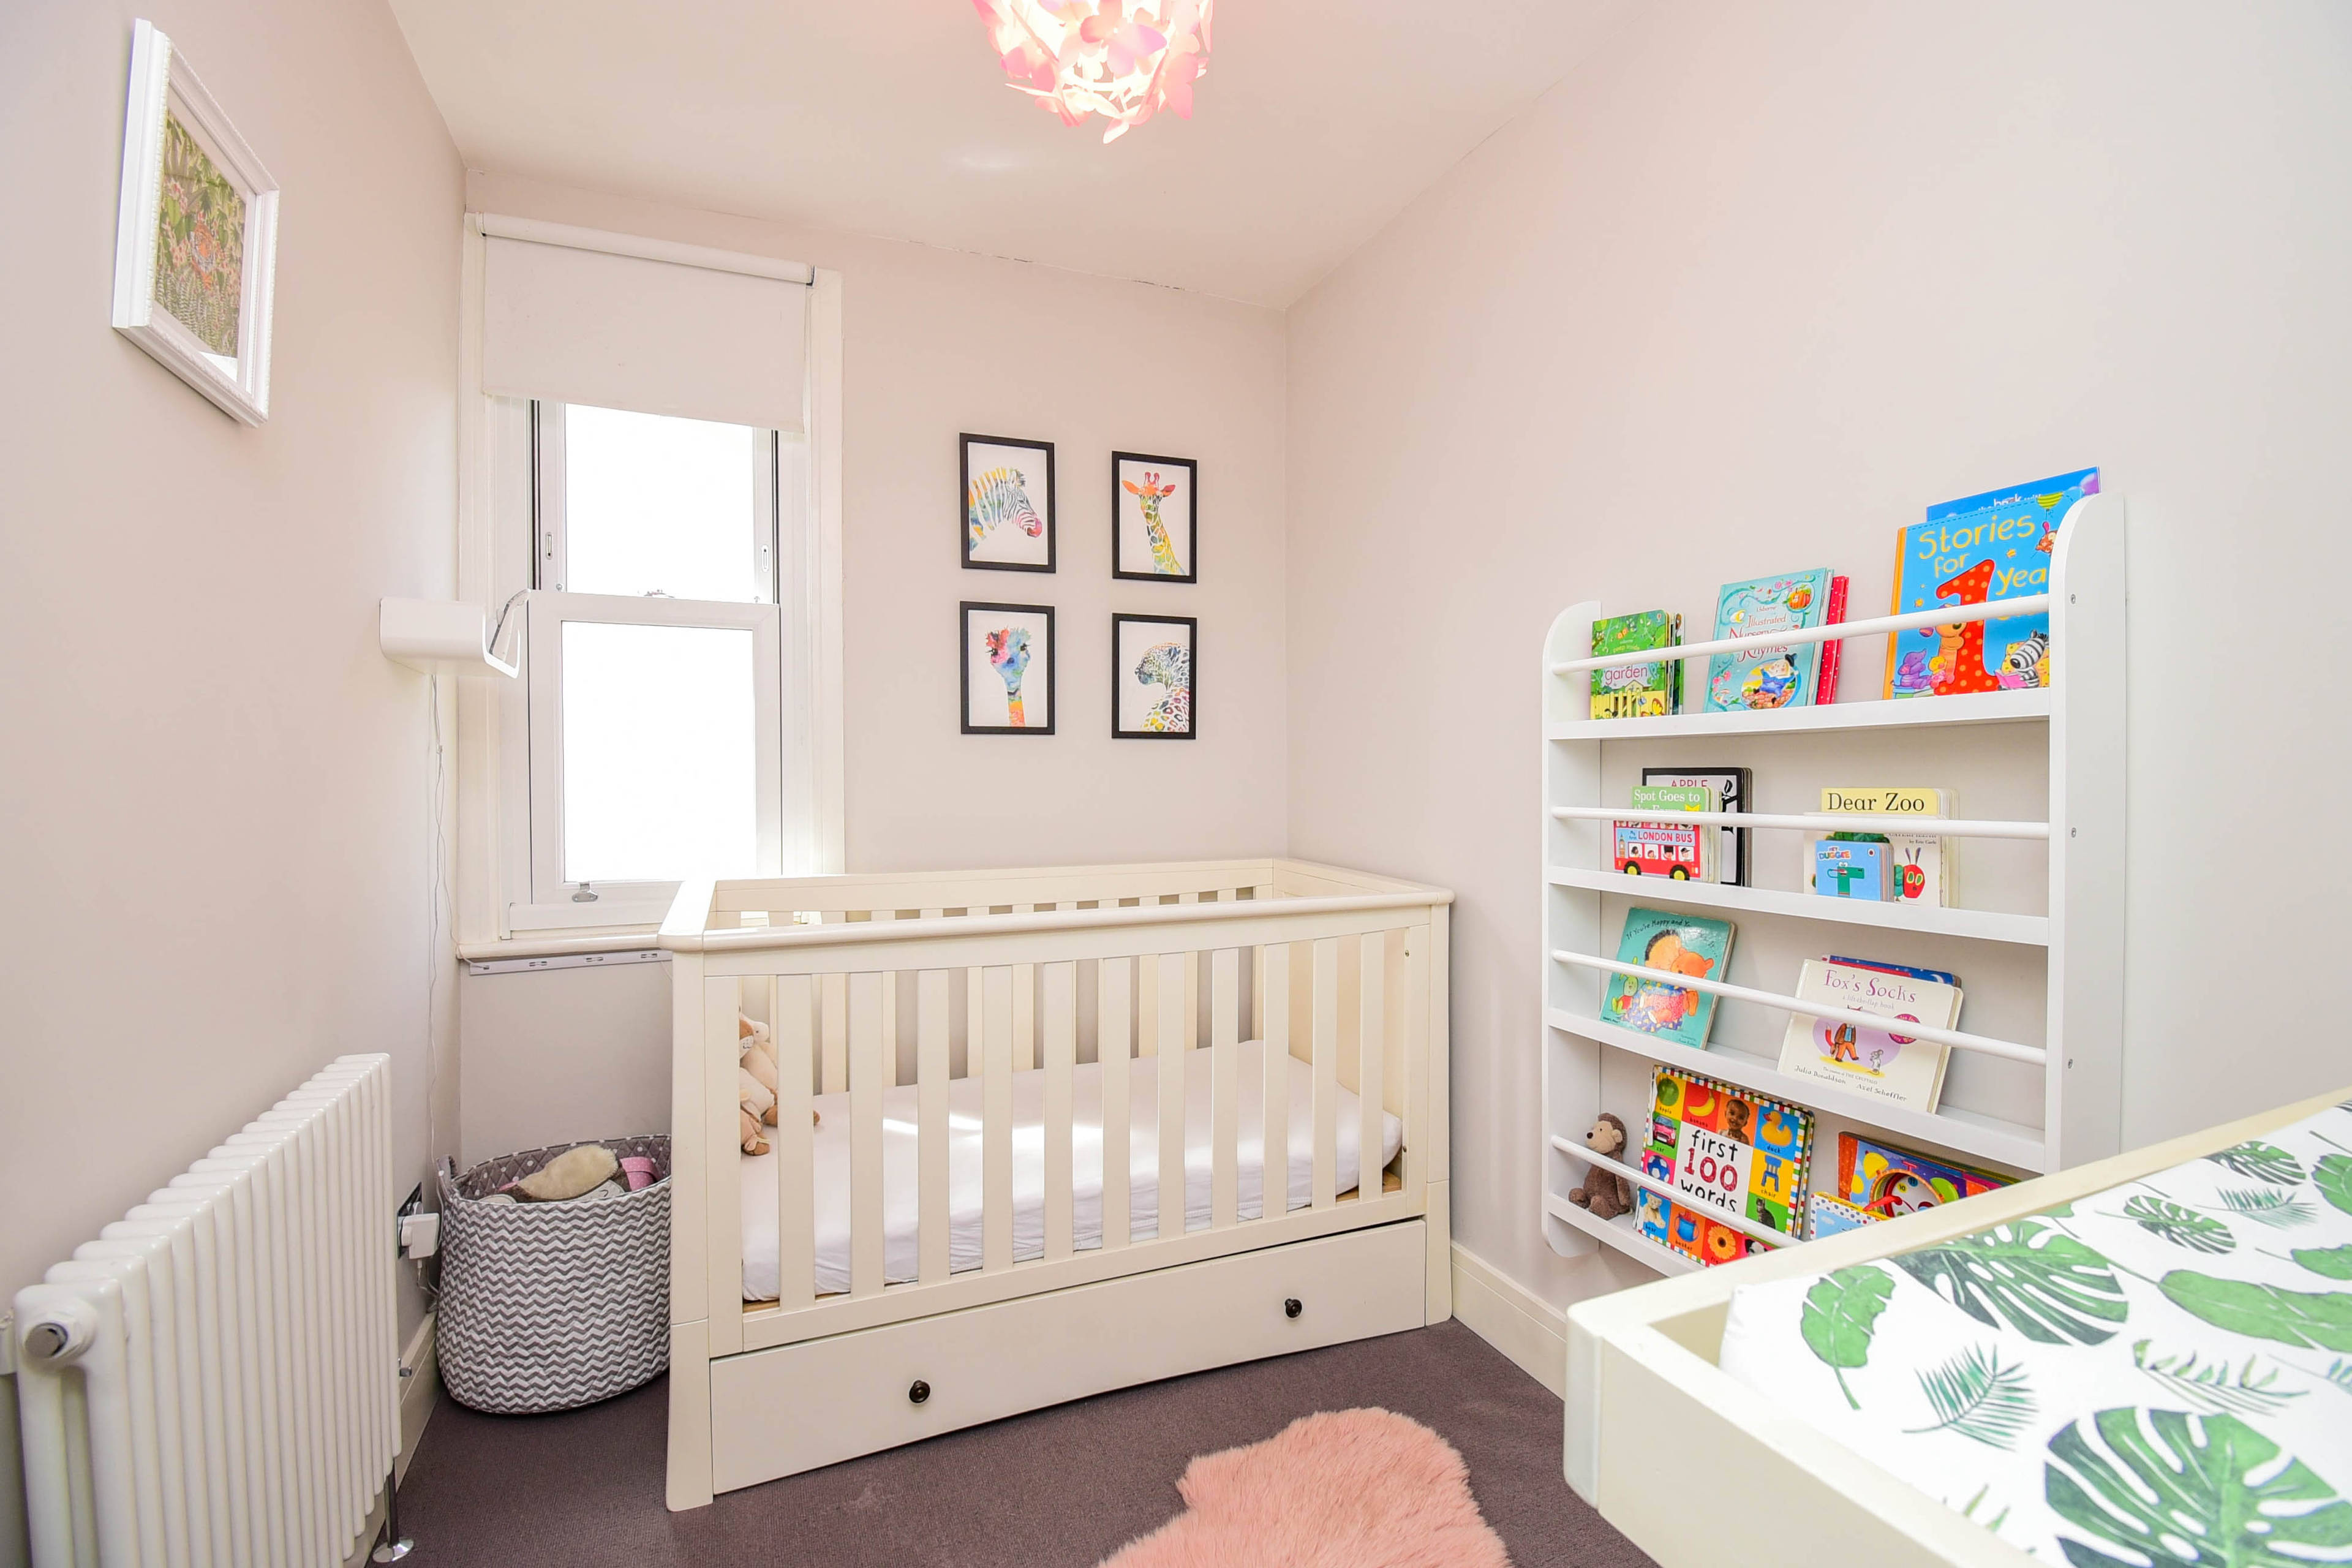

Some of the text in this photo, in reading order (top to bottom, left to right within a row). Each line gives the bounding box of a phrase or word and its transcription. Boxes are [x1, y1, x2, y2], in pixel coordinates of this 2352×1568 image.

[1919, 514, 2036, 559] Stories
[1934, 552, 1970, 578] for
[1995, 567, 2047, 595] yea
[1746, 612, 1787, 628] Illustrated
[1605, 665, 1648, 685] garden
[1634, 789, 1700, 803] Spot Goes to
[1827, 793, 1924, 811] Dear Zoo
[1638, 831, 1692, 843] LONDON BUS
[1824, 970, 1916, 1003] Fox's Socks
[1794, 1065, 1812, 1074] Julia
[1813, 1071, 1846, 1084] Donaldson
[1856, 1084, 1872, 1093] Axel
[1874, 1088, 1907, 1102] Scheffler
[1692, 1129, 1738, 1161] first
[1766, 1144, 1781, 1153] duck
[1684, 1147, 1738, 1192] 100
[1681, 1179, 1737, 1212] words
